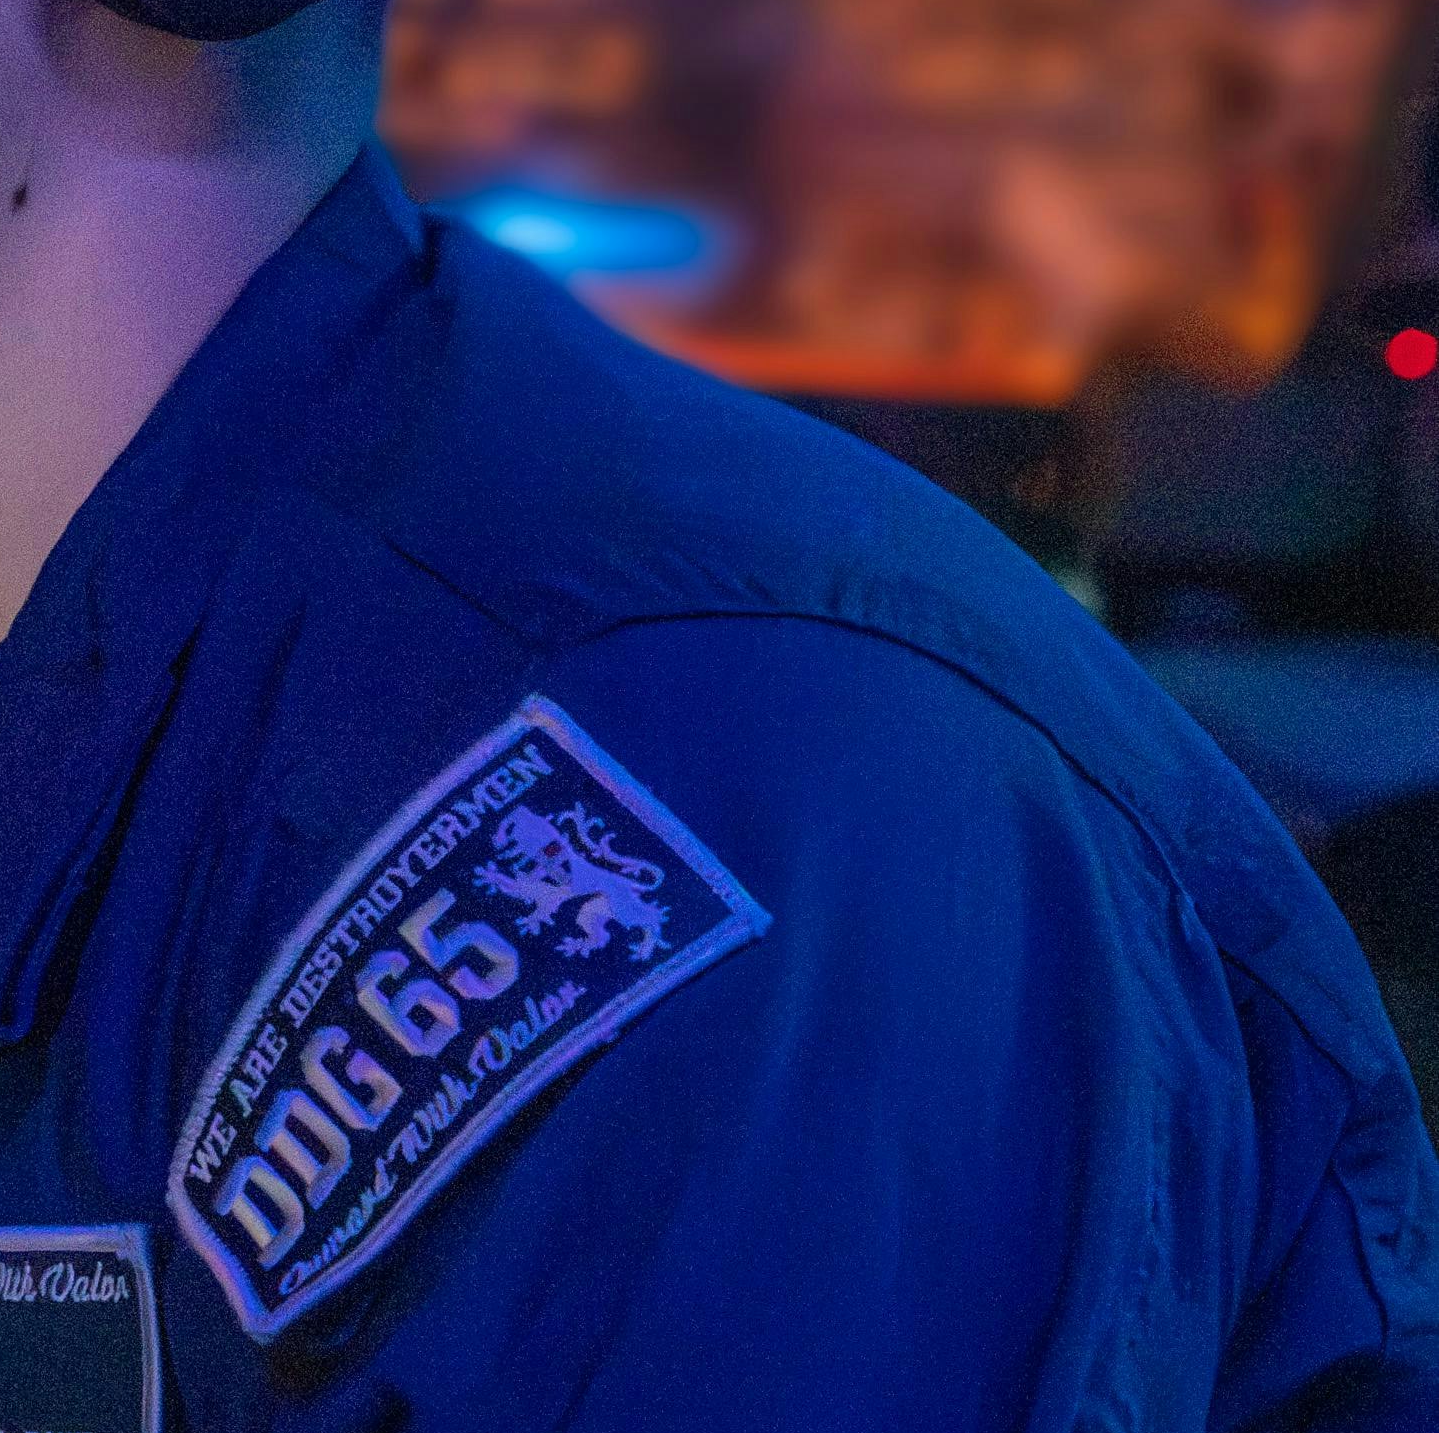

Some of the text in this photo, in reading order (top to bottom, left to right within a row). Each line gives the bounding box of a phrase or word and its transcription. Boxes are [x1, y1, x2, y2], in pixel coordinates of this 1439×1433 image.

[190, 744, 553, 1183] WE ARE DESTROYERMEN
[215, 887, 520, 1268] DDG 65
[39, 1261, 130, 1303] Valor
